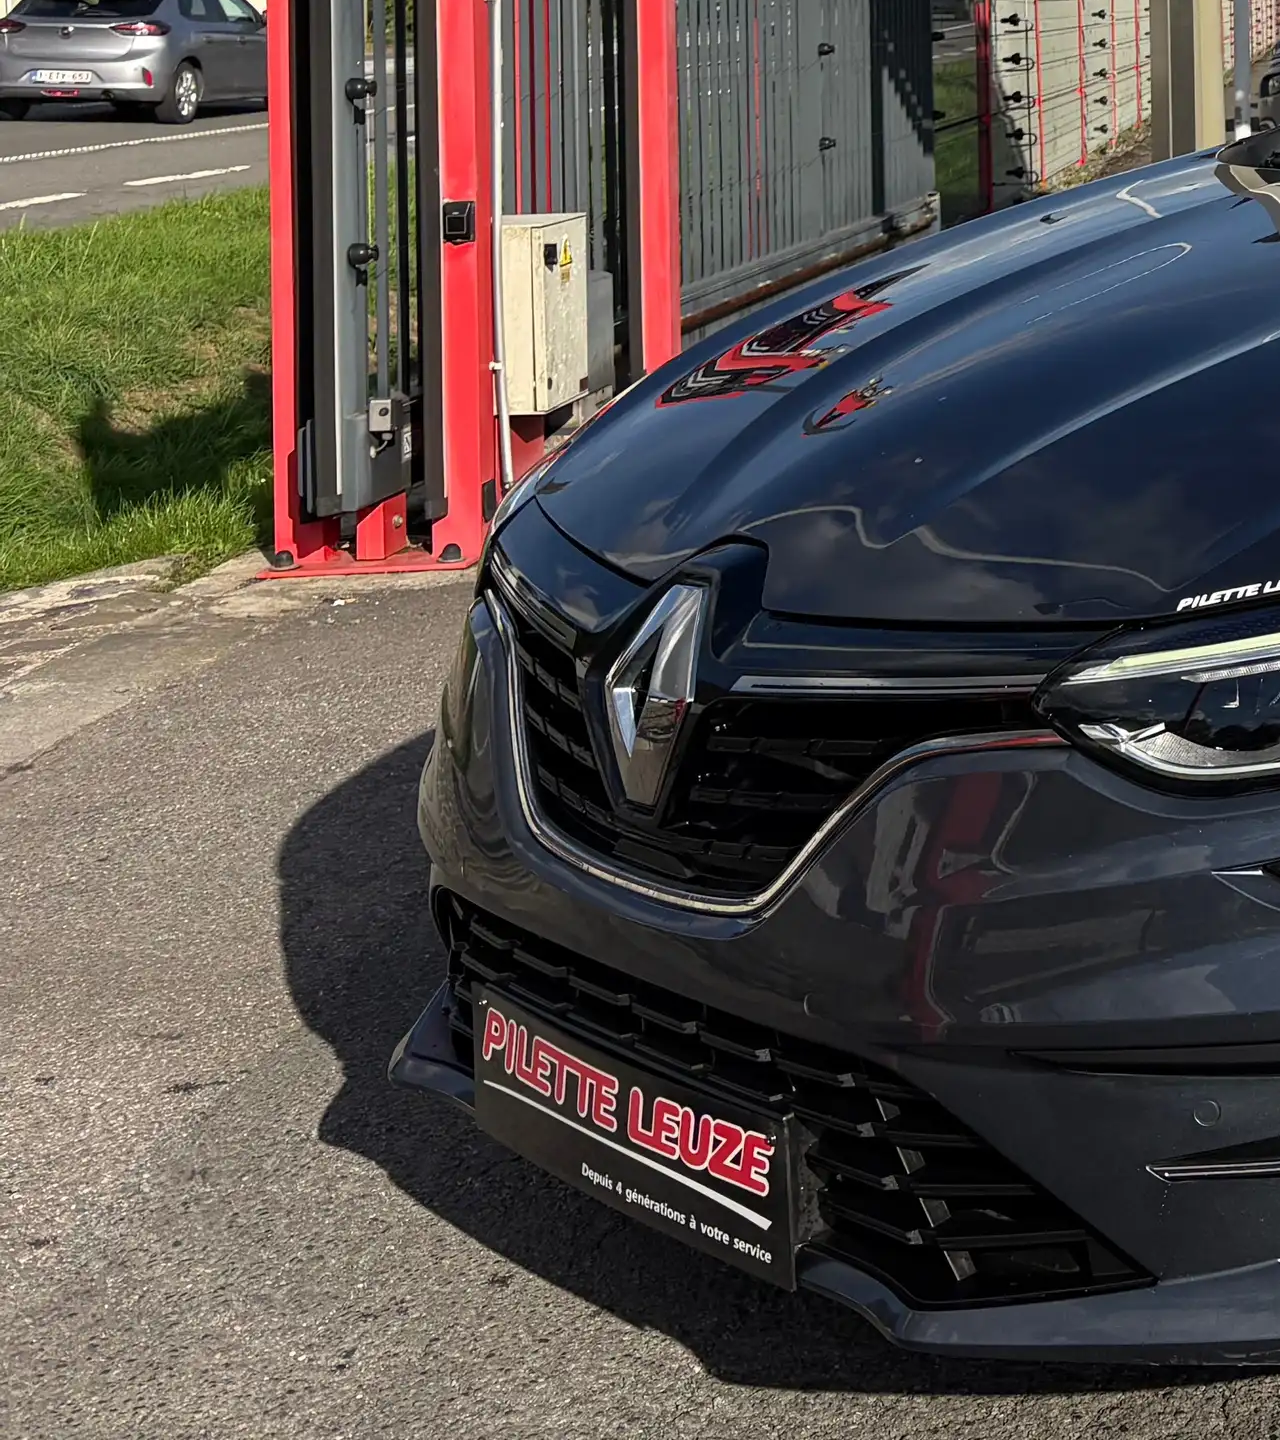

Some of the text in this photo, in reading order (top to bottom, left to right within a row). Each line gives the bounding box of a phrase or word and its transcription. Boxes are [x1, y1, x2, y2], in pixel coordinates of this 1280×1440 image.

[1176, 583, 1262, 612] PILETTE
[482, 1007, 776, 1197] PILETTE LEUZE
[581, 1162, 772, 1264] Depuis 4 générations à votre service
